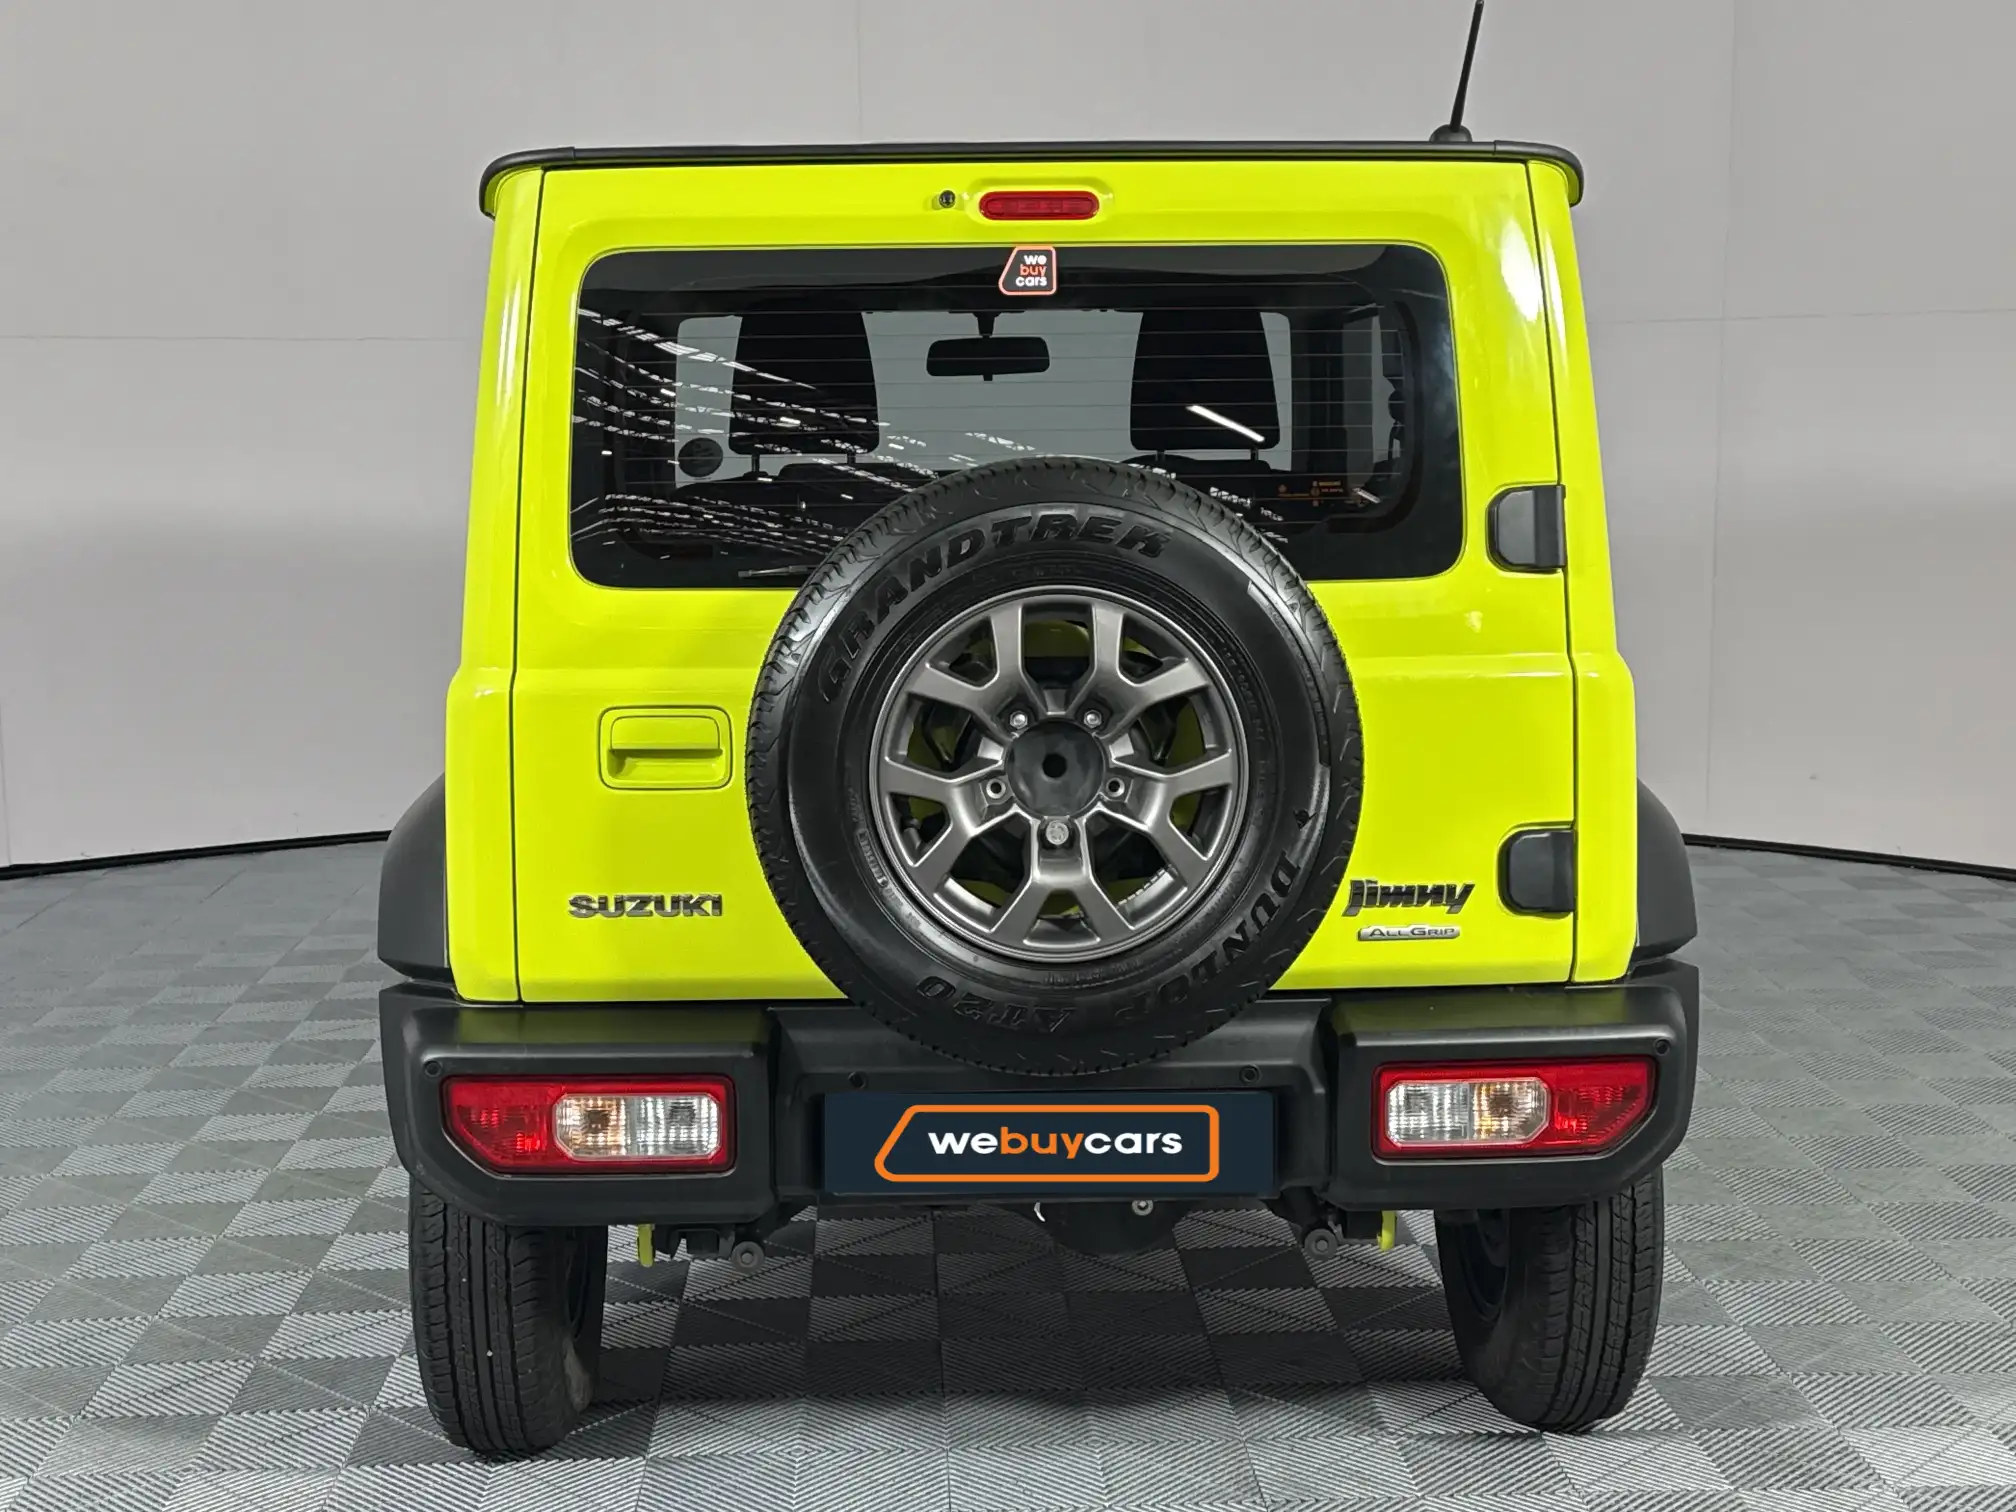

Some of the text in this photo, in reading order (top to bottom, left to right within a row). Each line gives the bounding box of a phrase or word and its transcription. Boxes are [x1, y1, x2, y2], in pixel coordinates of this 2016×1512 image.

[1020, 264, 1047, 277] buy
[1023, 255, 1047, 265] we
[1015, 276, 1048, 287] cars
[817, 512, 1173, 702] GRANDTREK
[568, 894, 723, 918] SUZUKI
[1341, 879, 1475, 917] Jimny
[1113, 851, 1301, 1024] DUNLOP
[928, 1126, 1183, 1159] webuycars
